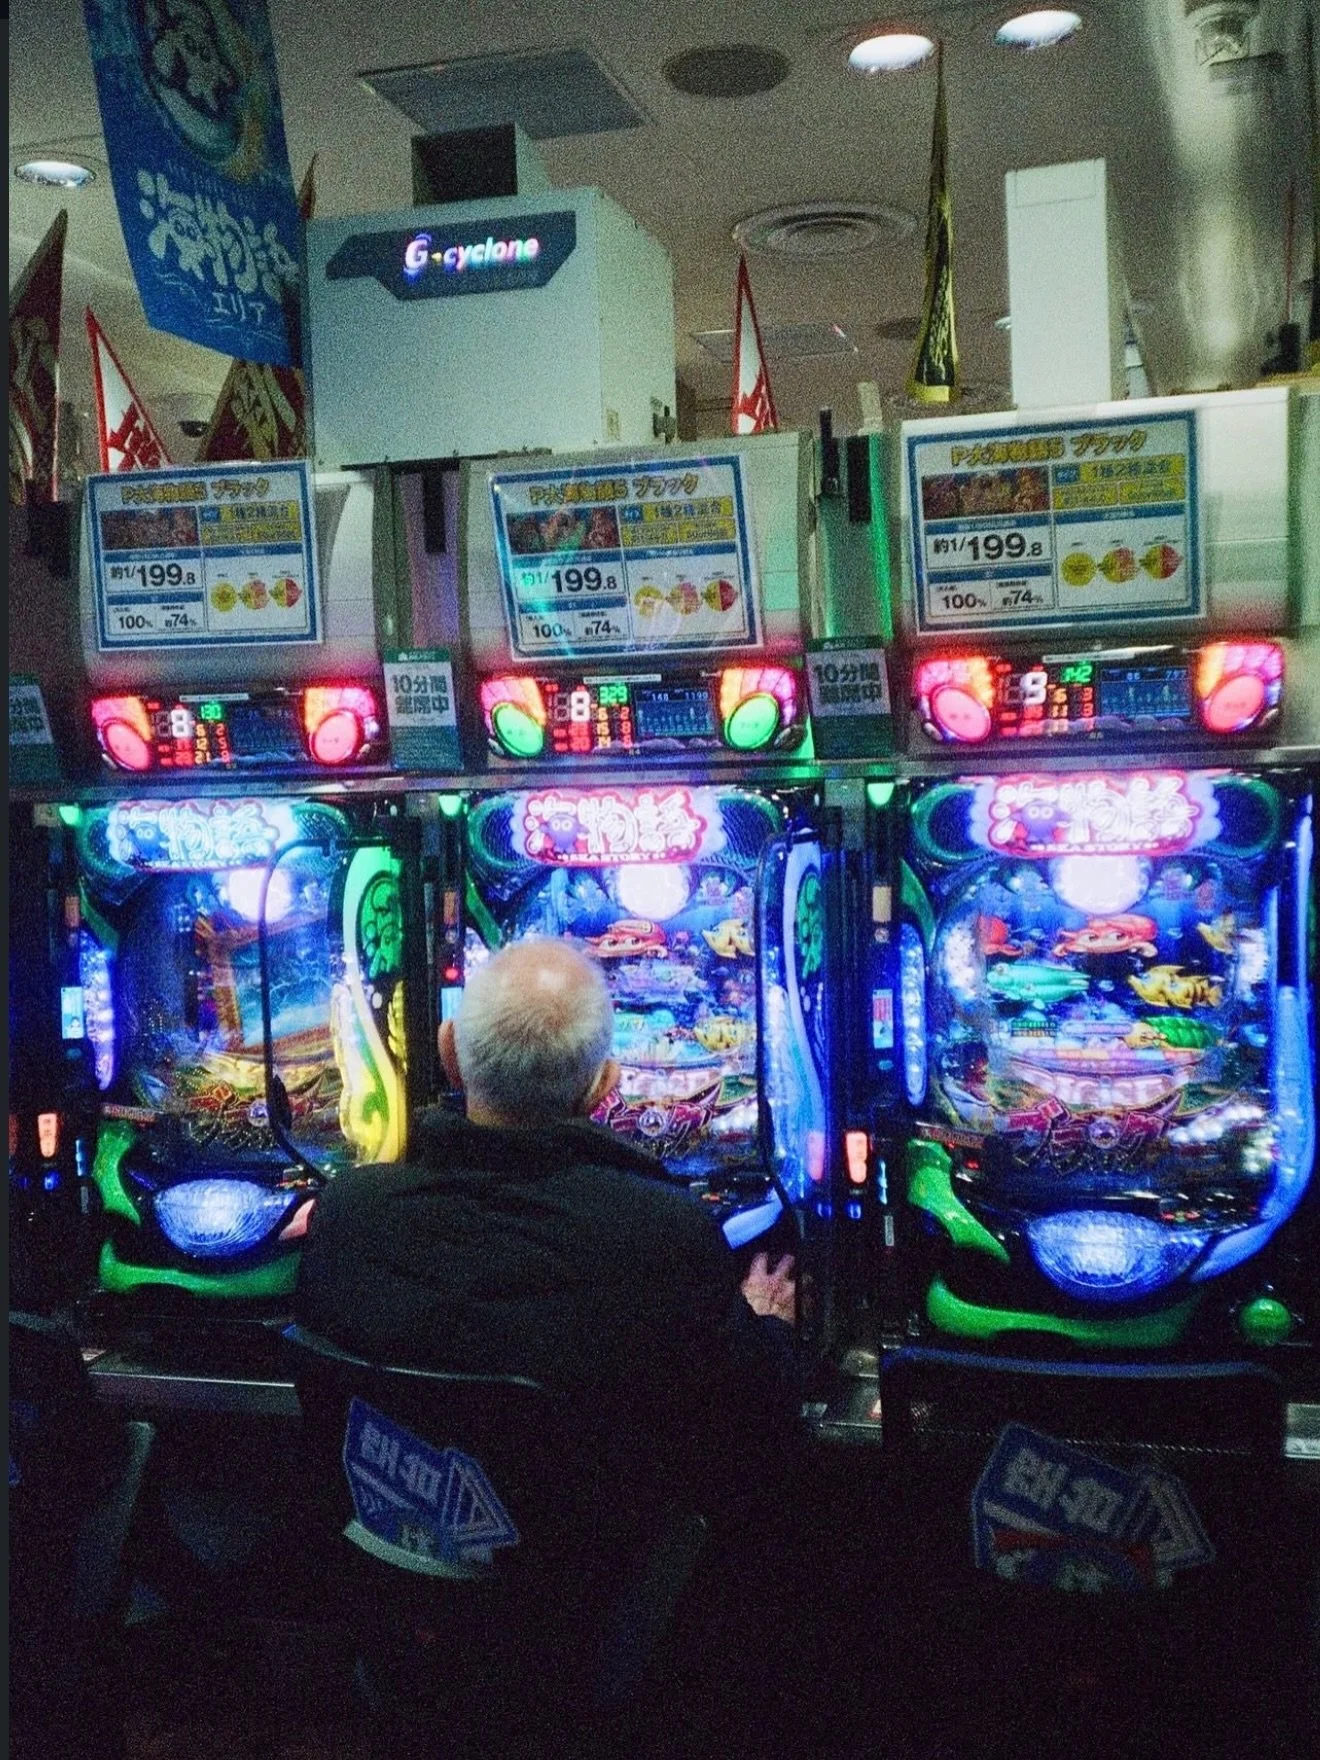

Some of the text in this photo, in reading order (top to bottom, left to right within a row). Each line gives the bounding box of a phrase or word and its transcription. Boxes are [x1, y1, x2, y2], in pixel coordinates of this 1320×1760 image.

[1073, 429, 1148, 454] ブラック
[632, 472, 699, 498] ブラック
[391, 674, 448, 694] 10分間
[599, 685, 629, 704] 329
[571, 690, 591, 722] 8
